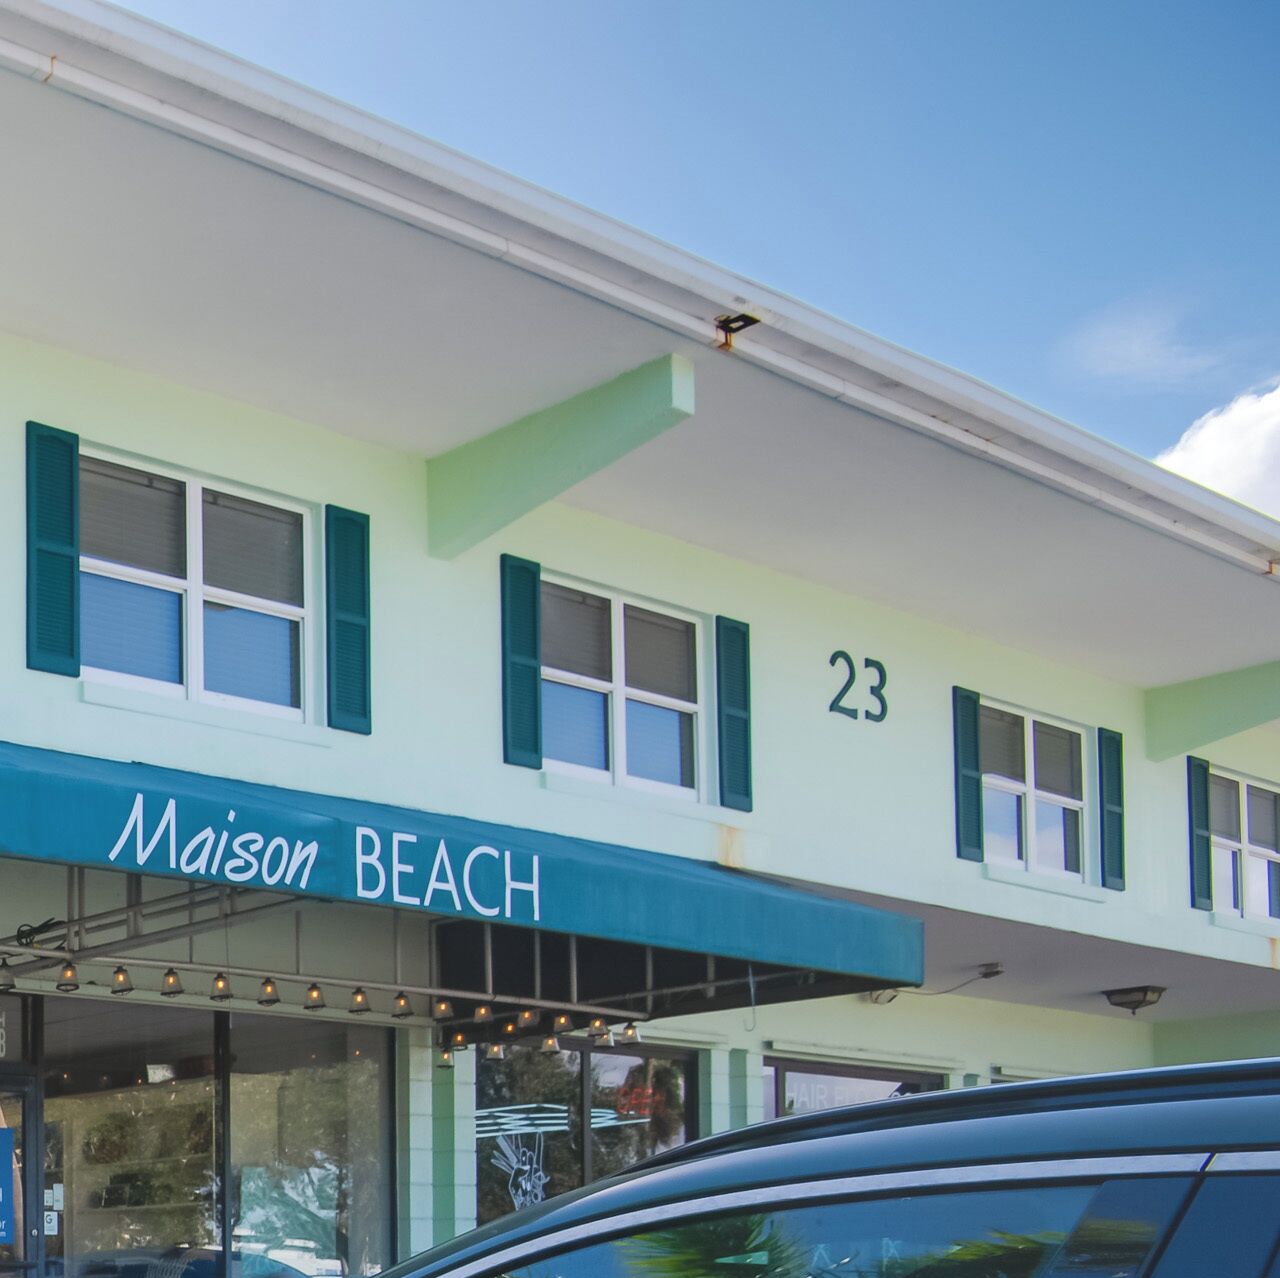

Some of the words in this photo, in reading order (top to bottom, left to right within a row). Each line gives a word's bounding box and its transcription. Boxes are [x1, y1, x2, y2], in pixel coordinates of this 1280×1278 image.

[829, 650, 888, 723] 23
[108, 792, 319, 889] Maison
[356, 825, 540, 921] BEACH
[786, 1082, 827, 1108] HAIR
